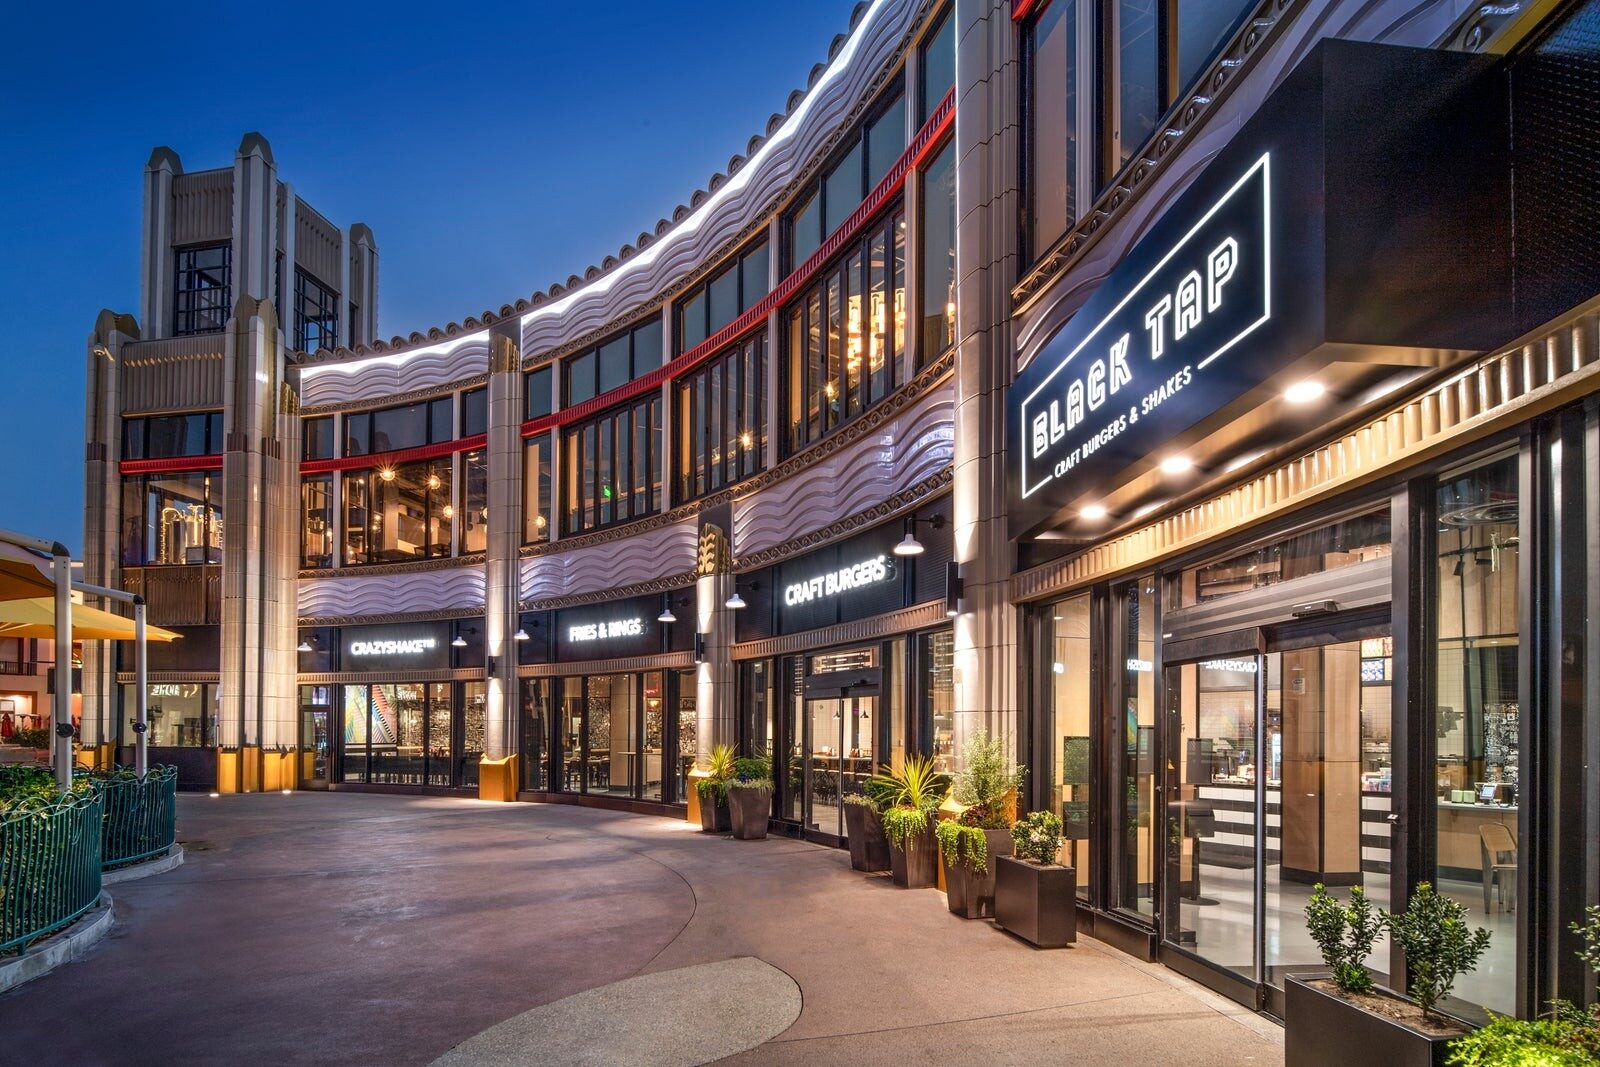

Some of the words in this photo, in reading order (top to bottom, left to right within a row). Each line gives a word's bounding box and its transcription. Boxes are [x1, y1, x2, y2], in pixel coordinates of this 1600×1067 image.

[1033, 332, 1132, 459] BLACK
[1145, 236, 1238, 360] TAP
[1054, 448, 1081, 478] CRAFT
[1082, 414, 1126, 459] BURGERS
[1129, 406, 1139, 424] &
[1141, 365, 1192, 415] SHAKES
[785, 576, 825, 606] CRAFT
[825, 555, 886, 596] BURGERS
[569, 624, 597, 642] FRIES
[598, 622, 607, 639] &
[608, 618, 641, 637] RINGS
